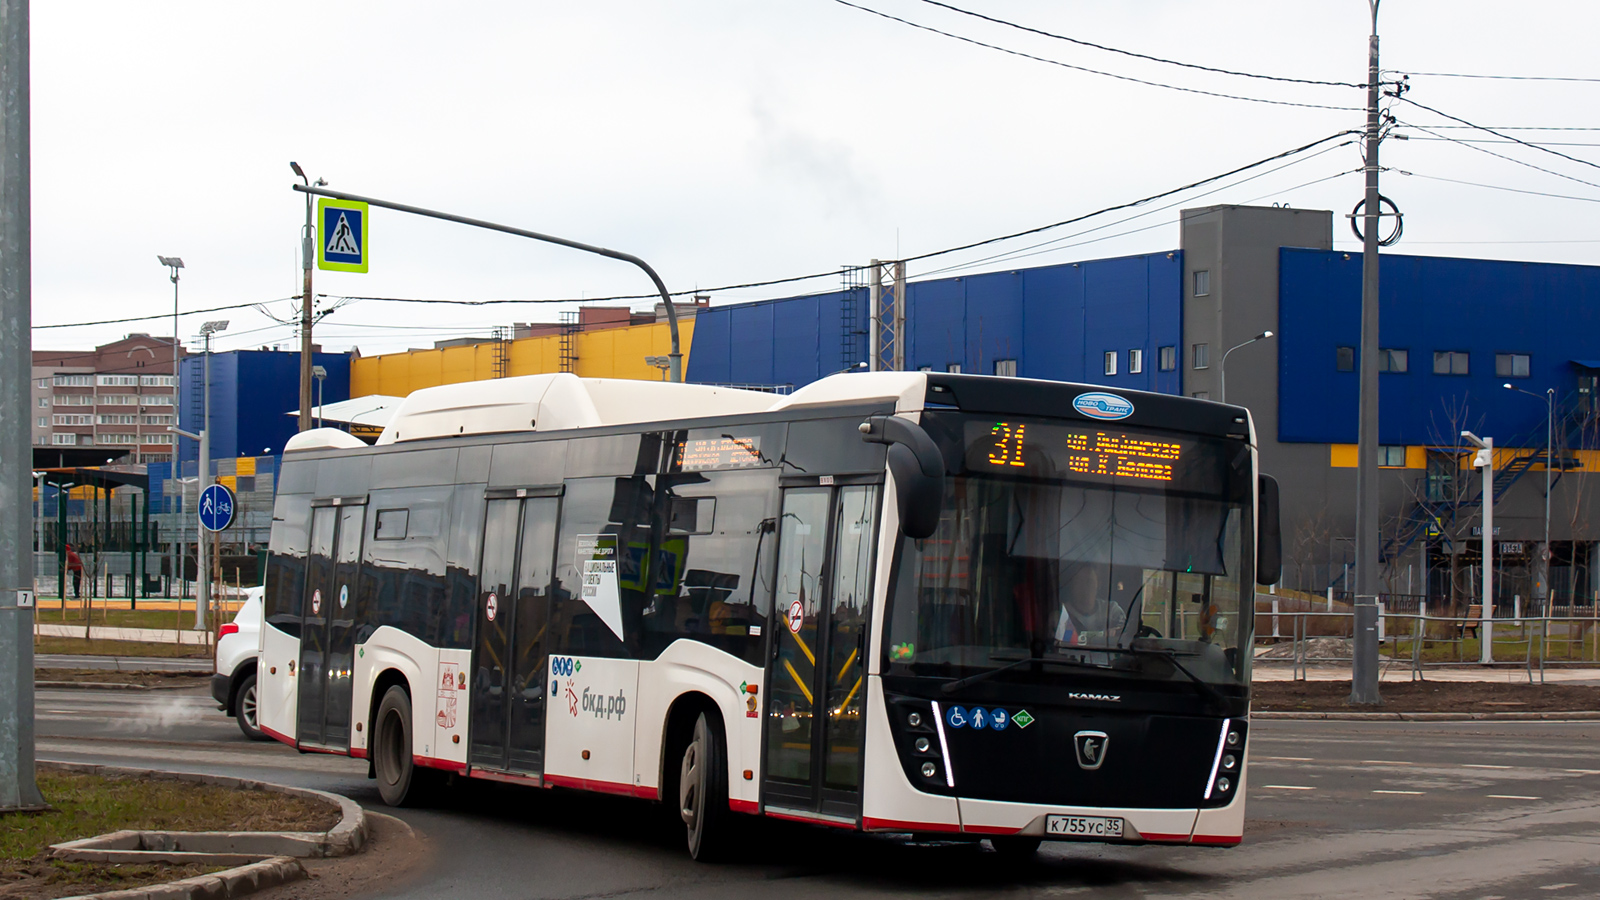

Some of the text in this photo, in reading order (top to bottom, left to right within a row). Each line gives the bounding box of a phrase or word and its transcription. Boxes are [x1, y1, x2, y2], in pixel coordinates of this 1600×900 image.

[1105, 406, 1128, 414] ТРАНС
[988, 422, 1025, 467] 31
[583, 561, 616, 573] НАЦИОНАЛЬНЫЕ
[583, 573, 602, 585] ПРОЕКТЫ
[22, 593, 28, 604] 7
[1069, 692, 1121, 702] KAMAZ
[582, 686, 626, 721] бкд.рф
[1016, 715, 1030, 723] КПГ
